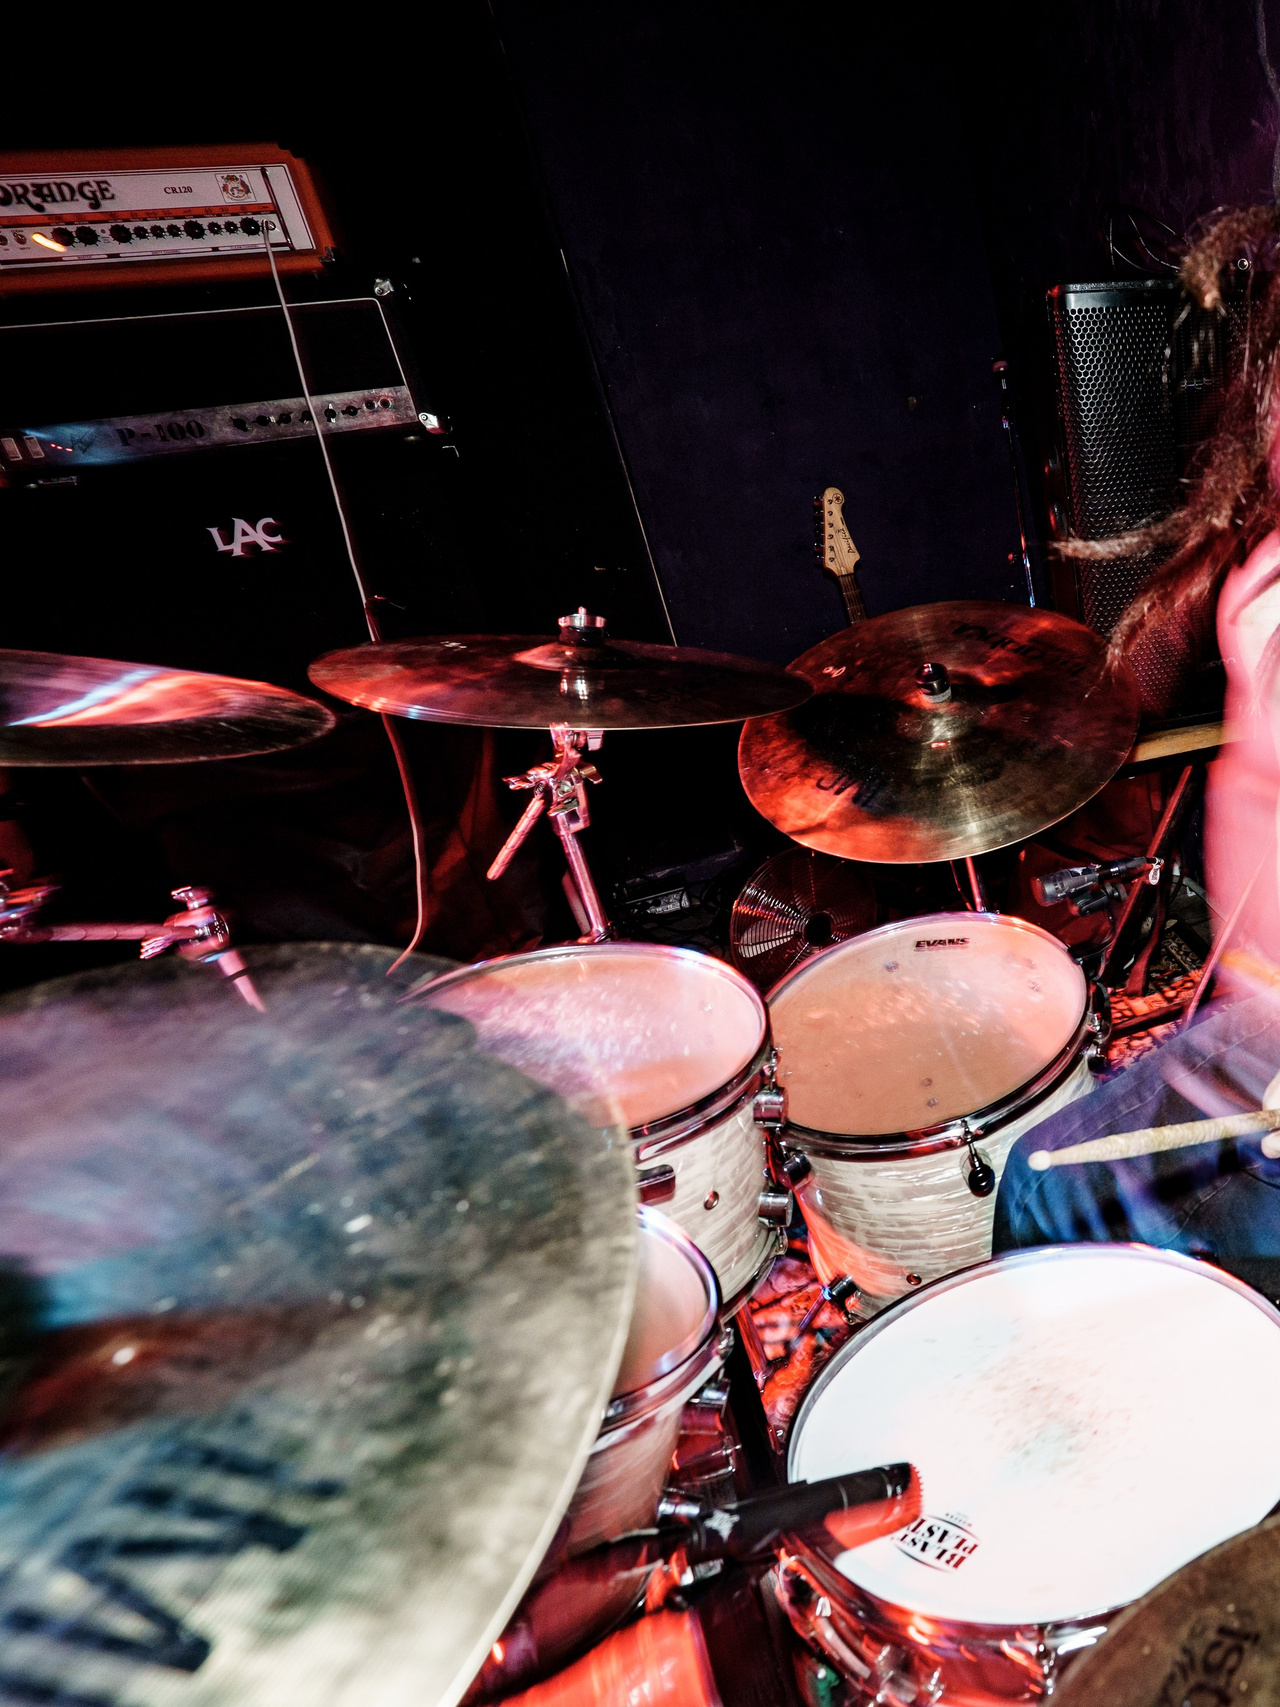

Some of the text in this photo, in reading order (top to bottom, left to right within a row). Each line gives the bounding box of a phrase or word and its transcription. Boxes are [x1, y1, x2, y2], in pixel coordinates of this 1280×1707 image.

[163, 185, 193, 195] CR120
[115, 419, 206, 447] P-100
[206, 516, 284, 557] LAC
[915, 938, 970, 948] EVANS
